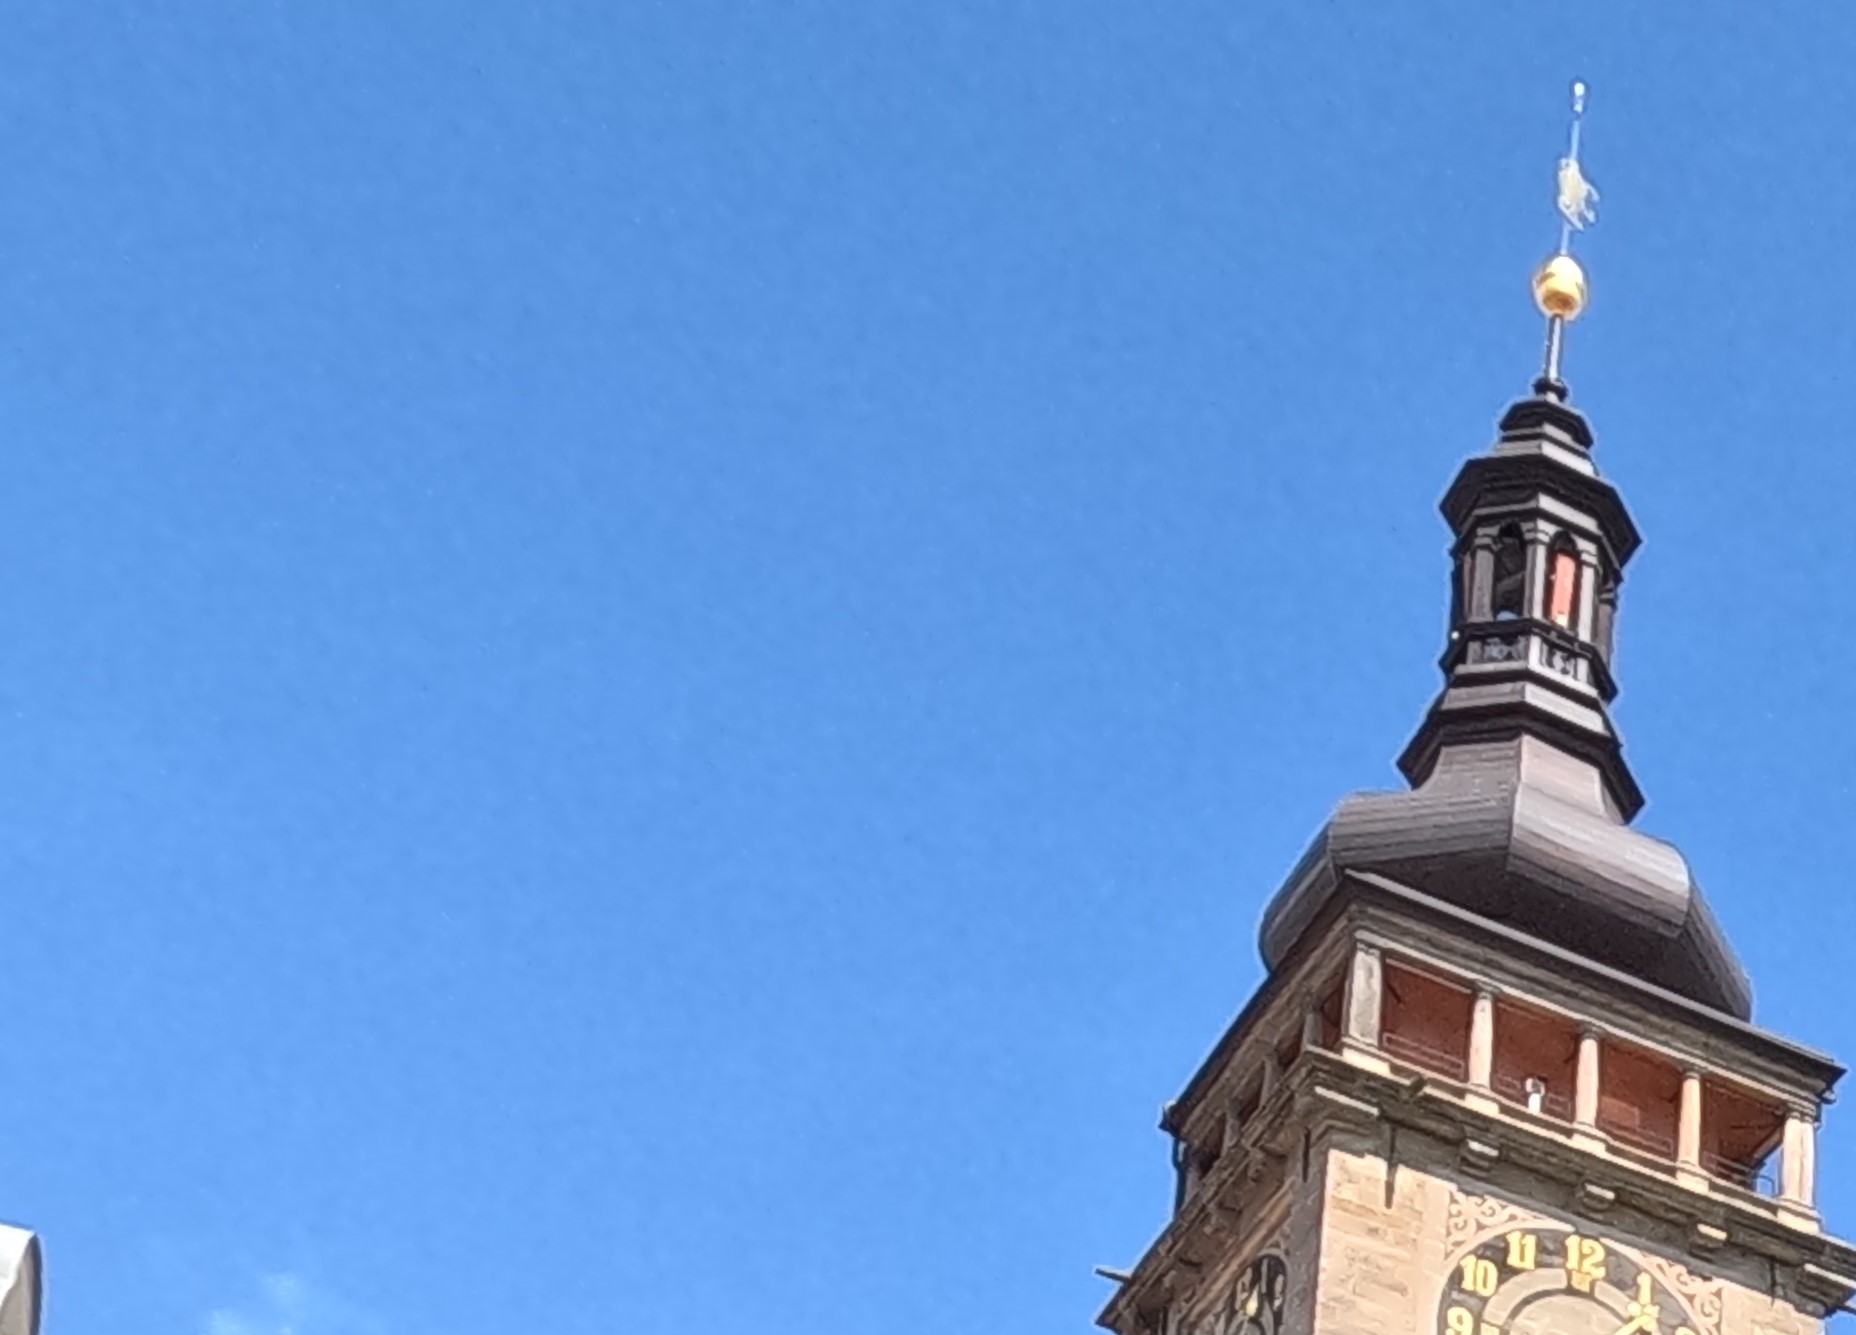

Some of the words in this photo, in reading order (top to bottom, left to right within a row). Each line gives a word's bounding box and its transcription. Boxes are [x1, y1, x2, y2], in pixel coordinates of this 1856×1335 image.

[1506, 1231, 1537, 1270] 11
[1565, 1235, 1606, 1281] 12
[1460, 1254, 1498, 1297] 10
[1636, 1271, 1652, 1306] 1
